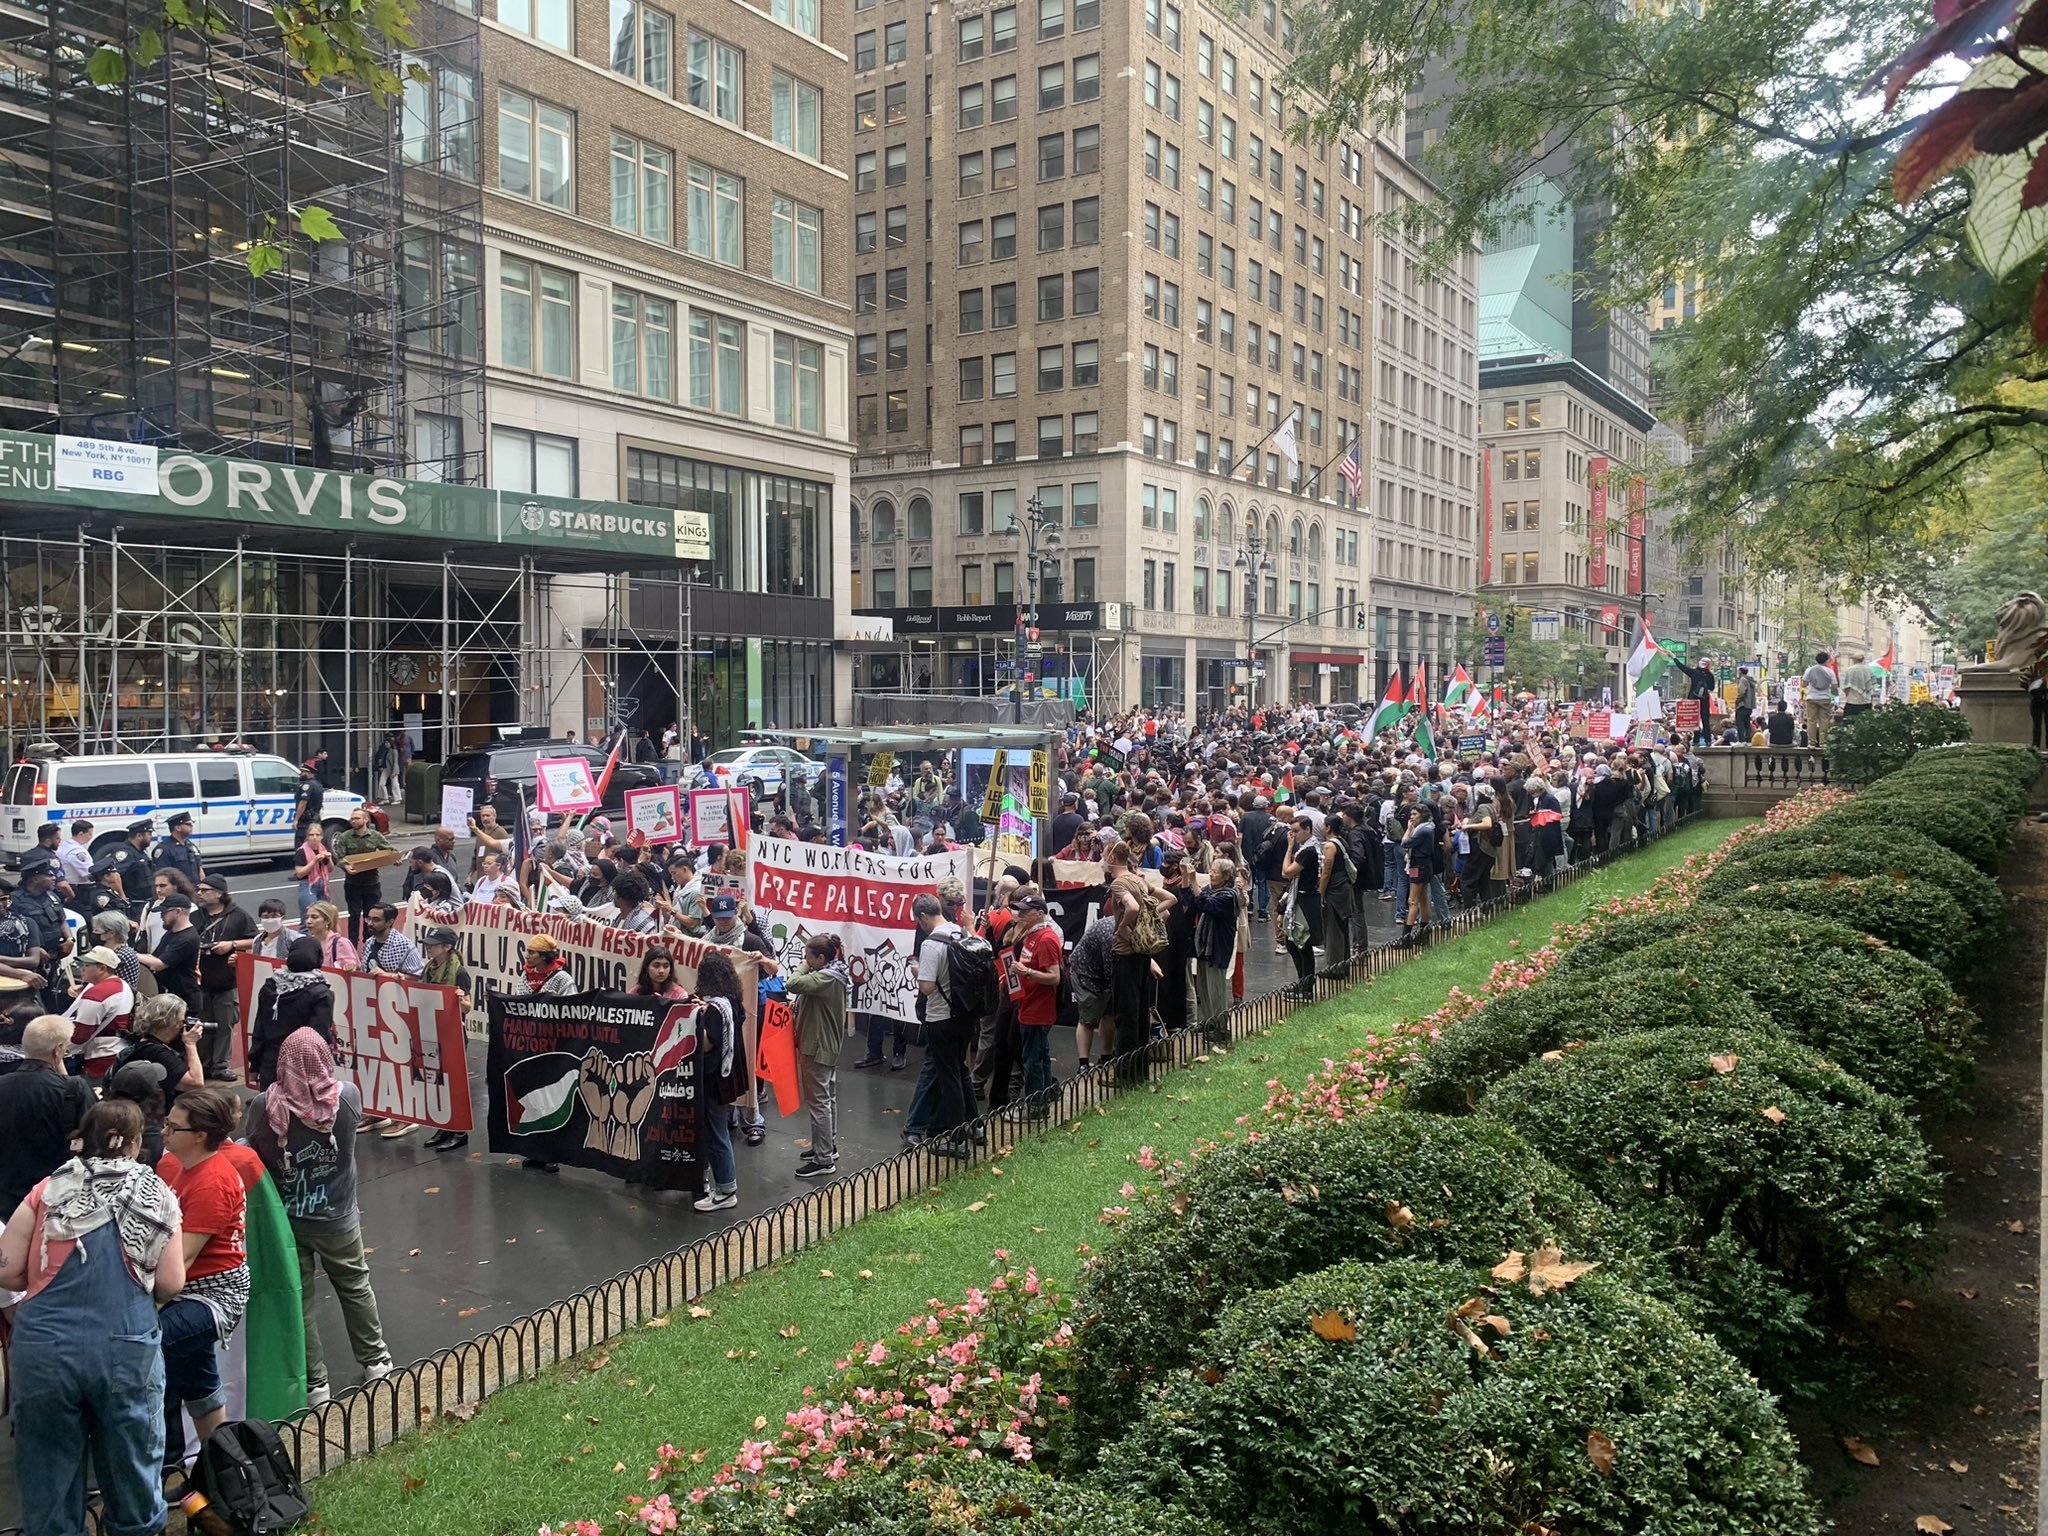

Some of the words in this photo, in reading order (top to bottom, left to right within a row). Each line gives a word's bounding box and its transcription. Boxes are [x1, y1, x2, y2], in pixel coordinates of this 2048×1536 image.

[62, 448, 82, 457] New
[85, 451, 108, 461] York,
[127, 456, 151, 465] 10017
[77, 441, 95, 450] 489
[99, 443, 114, 452] 5th
[117, 446, 137, 455] Ave.
[93, 468, 124, 481] RBG
[159, 455, 407, 525] ORVIS
[549, 510, 668, 538] STARBUCKS
[677, 524, 708, 538] KINGS
[1631, 548, 1642, 577] Library
[956, 614, 972, 622] Robb
[972, 614, 992, 623] Report
[831, 780, 840, 821] Avenue
[63, 805, 138, 819] AUXILIARY
[831, 823, 840, 831] &
[757, 840, 792, 865] NYC
[804, 848, 887, 877] WORKERS
[897, 861, 935, 880] FOR
[759, 870, 816, 910] FREE
[463, 902, 501, 929] WITH
[504, 907, 597, 948] PALESTINIAN
[501, 1001, 560, 1020] LEBANON
[560, 1004, 590, 1021] AND
[502, 1017, 537, 1037] HAND
[554, 1023, 589, 1040] HAND
[591, 1025, 621, 1044] UNTIL
[502, 1032, 558, 1053] VICTORY
